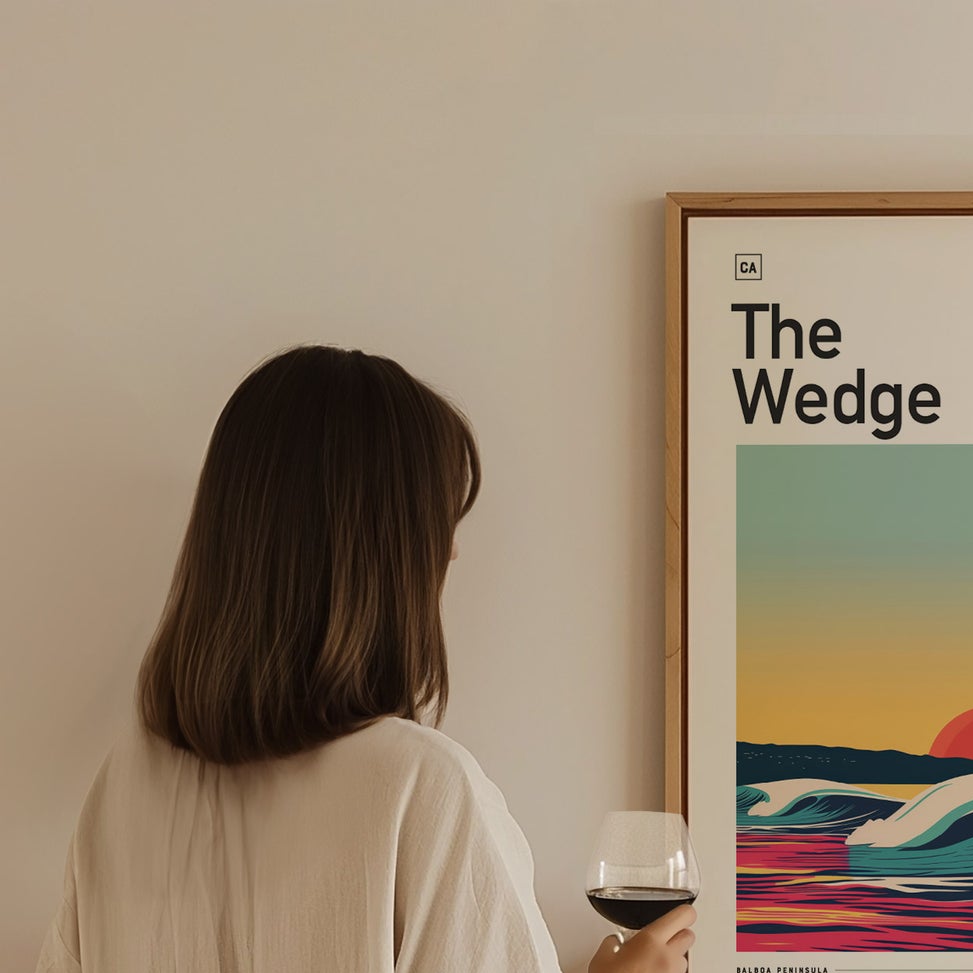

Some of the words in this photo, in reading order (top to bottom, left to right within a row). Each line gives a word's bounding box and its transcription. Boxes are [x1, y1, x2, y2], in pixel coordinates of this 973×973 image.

[739, 260, 758, 275] CA
[731, 303, 842, 359] The
[732, 368, 942, 440] Wedge
